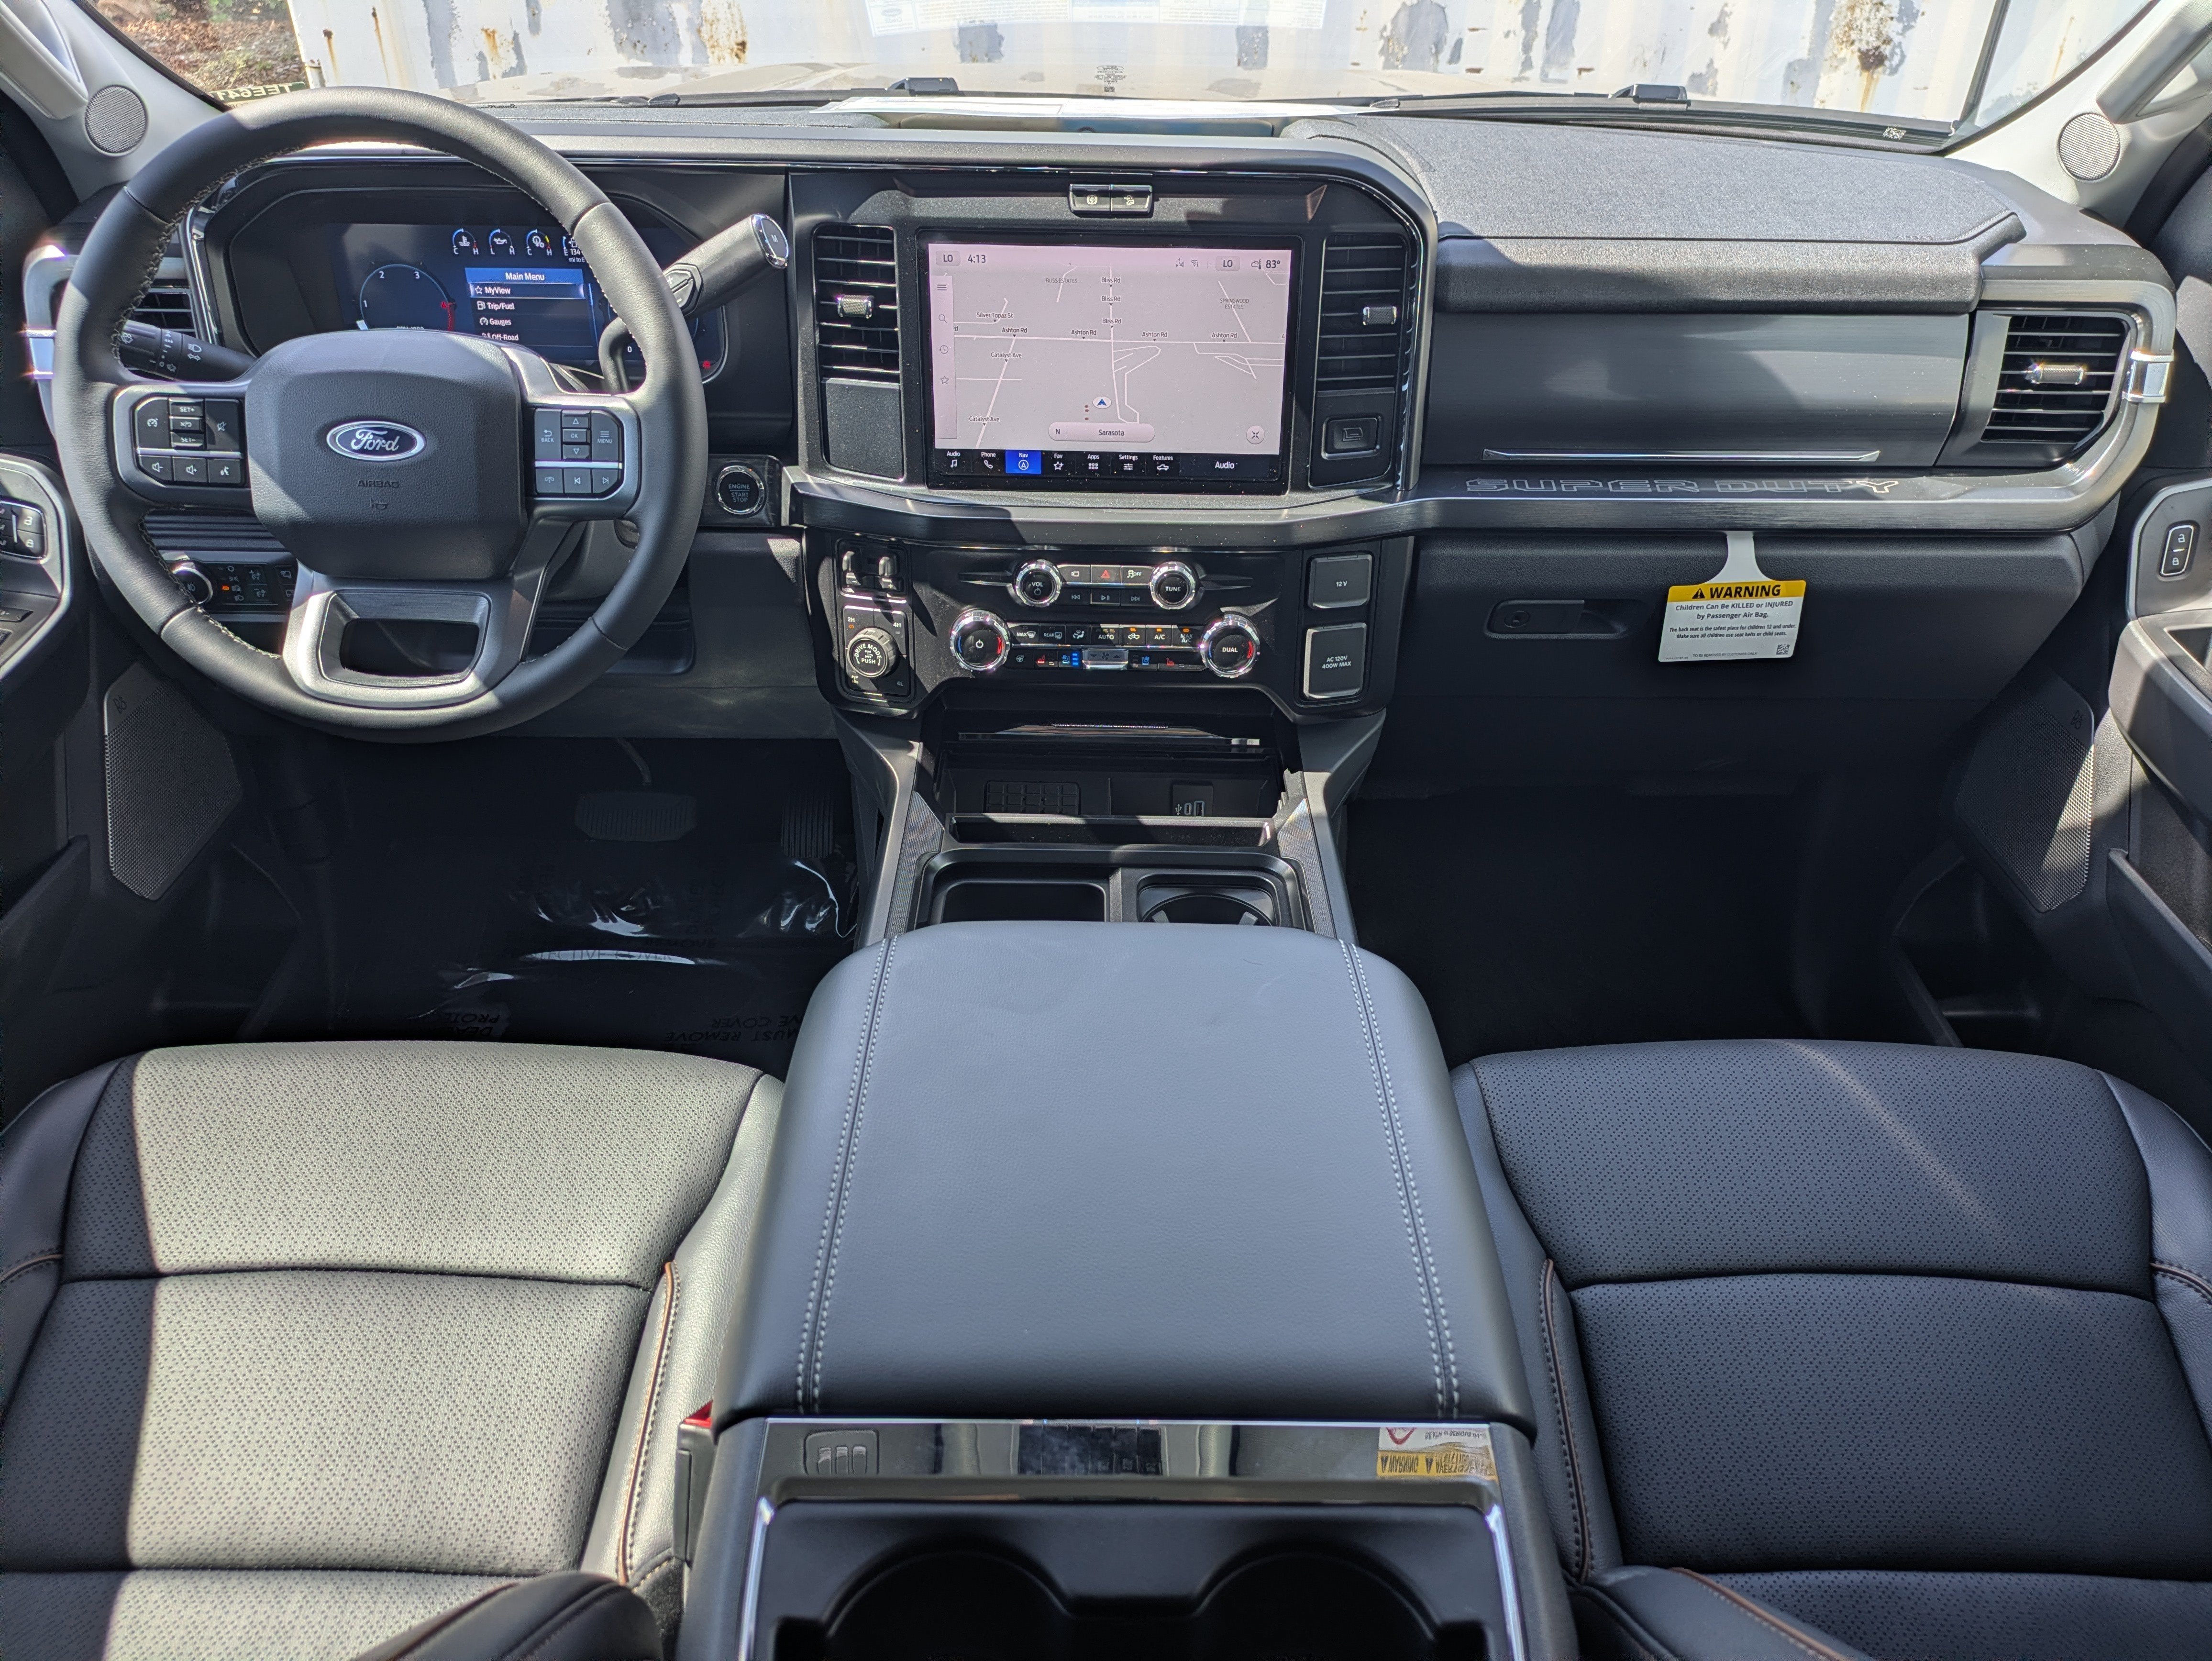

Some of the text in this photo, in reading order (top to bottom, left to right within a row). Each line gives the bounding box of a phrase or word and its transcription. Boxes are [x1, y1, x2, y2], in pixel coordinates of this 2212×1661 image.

[943, 254, 986, 264] LO 4:13
[1223, 259, 1233, 268] LO
[506, 272, 544, 281] Main Menu
[485, 287, 510, 295] MyView
[487, 302, 515, 310] Trip/Fuel
[489, 318, 512, 327] Gauges
[351, 429, 400, 451] Ford
[1215, 461, 1235, 469] Audio
[357, 480, 400, 488] AIRBAG
[1465, 479, 1900, 494] SUPER DUTY
[1709, 584, 1781, 598] WARNING
[854, 643, 882, 659] DRIVE MODE
[712, 1017, 770, 1029] COVER
[664, 1030, 741, 1042] REMOVE
